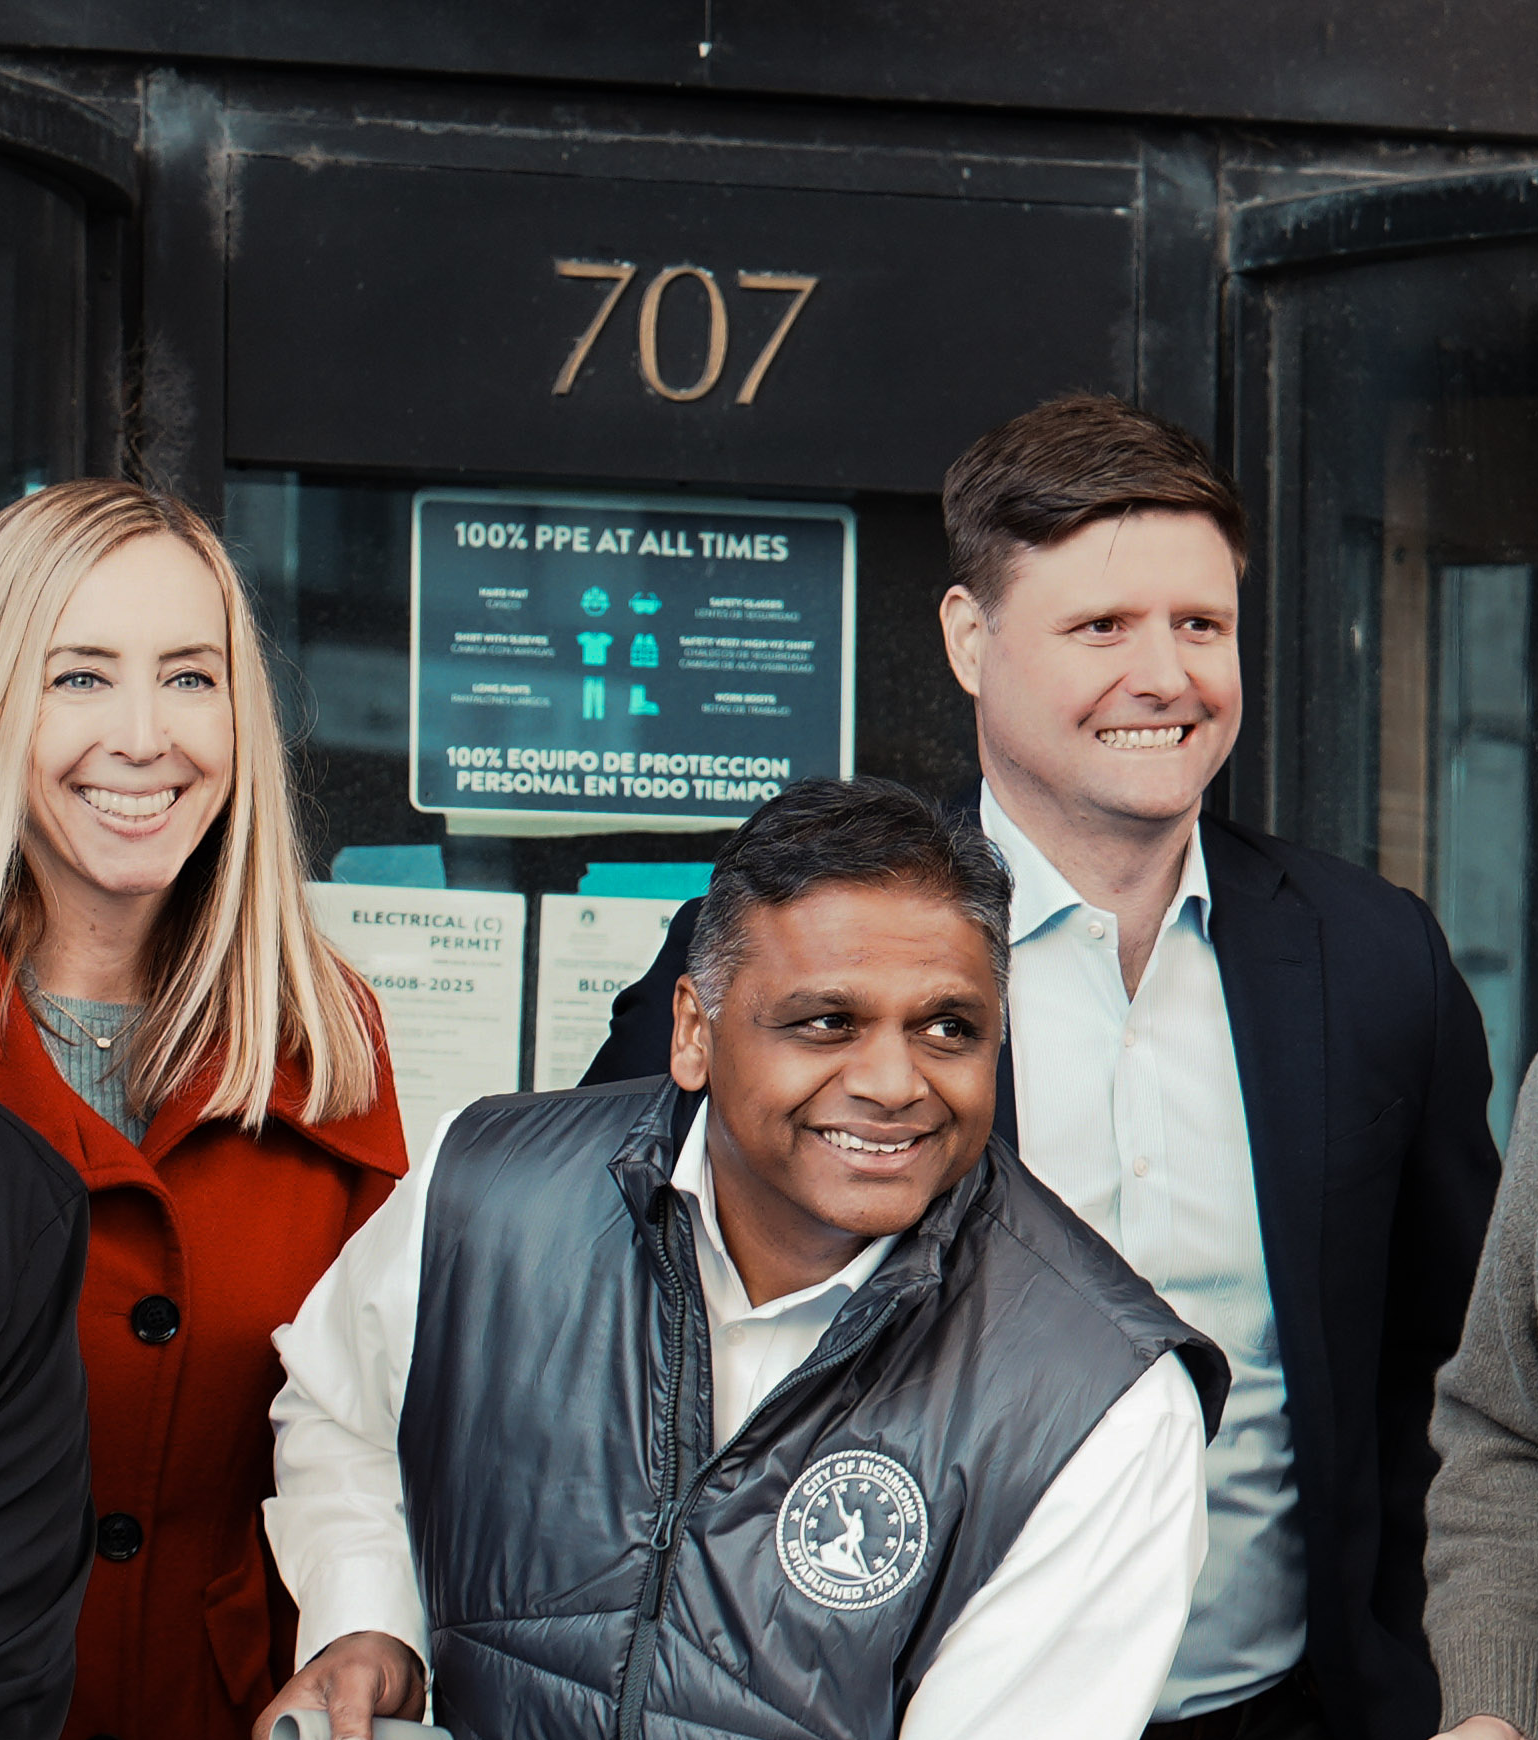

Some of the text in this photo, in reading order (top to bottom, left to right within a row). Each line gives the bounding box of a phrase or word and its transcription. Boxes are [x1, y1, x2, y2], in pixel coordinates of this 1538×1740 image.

[551, 257, 820, 405] 707
[454, 521, 789, 562] 100% PPE AT ALL TIMES
[446, 747, 790, 778] 100% EQUIPO DE PROTECCION
[456, 771, 781, 802] PERSONAL EN TODO TIEMPO
[351, 910, 503, 933] ELECTRICAL (C)
[430, 935, 502, 951] PERMIT
[802, 1460, 918, 1523] CITY OF RICHMOND
[787, 1539, 864, 1599] ESTABLISHED
